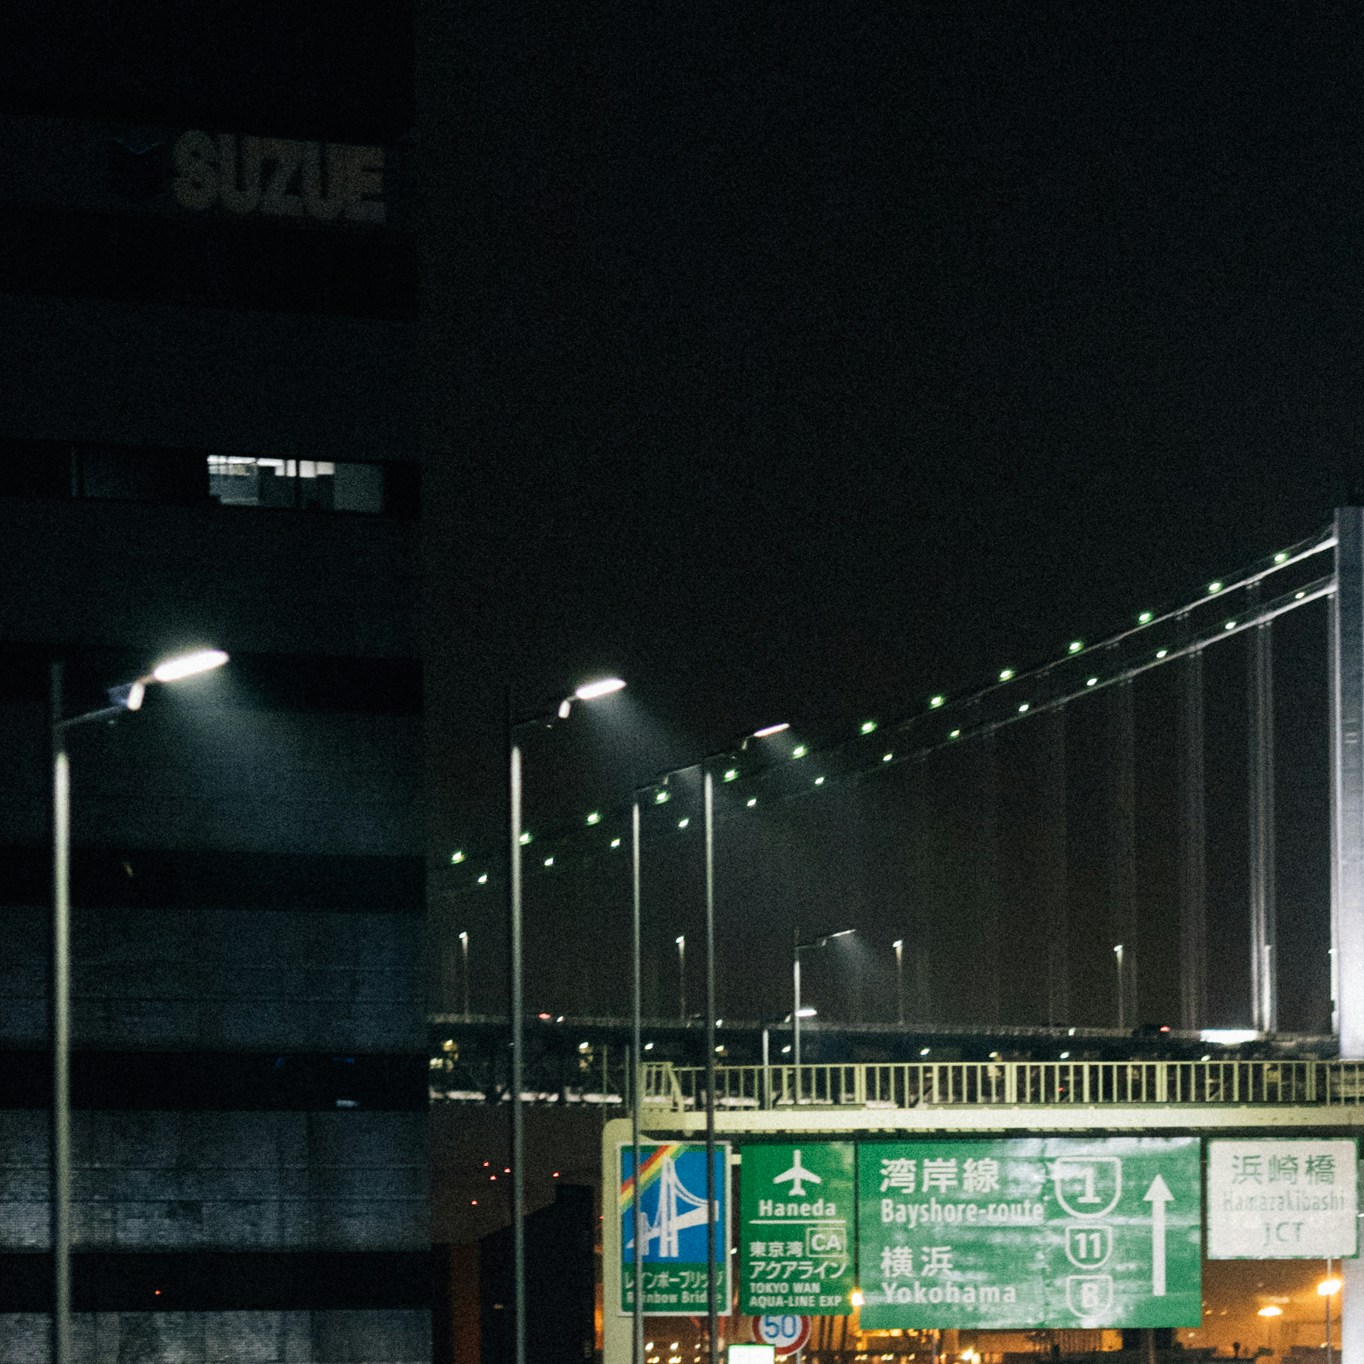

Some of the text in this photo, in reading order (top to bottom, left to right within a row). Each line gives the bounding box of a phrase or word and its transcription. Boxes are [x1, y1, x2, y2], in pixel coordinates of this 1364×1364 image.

[172, 129, 386, 224] SUZUE
[880, 1158, 1000, 1194] 湾岸線
[1231, 1154, 1336, 1185] 浜崎橋
[1078, 1167, 1101, 1203] 1
[758, 1199, 837, 1217] Haneda
[880, 1198, 1045, 1228] Bayshore-route
[1223, 1190, 1345, 1212] Hamazakibashi
[811, 1234, 842, 1251] CA
[1074, 1232, 1101, 1259] 11
[1263, 1221, 1304, 1247] JCT
[749, 1241, 803, 1257] 東京湾
[749, 1261, 847, 1279] アクアライン
[881, 1246, 954, 1278] 横浜
[626, 1291, 722, 1303] Rinbow Bride
[749, 1282, 821, 1293] TOKYO WAN
[880, 1282, 1017, 1304] Yokohama
[1081, 1282, 1099, 1309] B
[749, 1295, 842, 1308] AQUA-LINE EXP
[764, 1314, 797, 1339] 50
